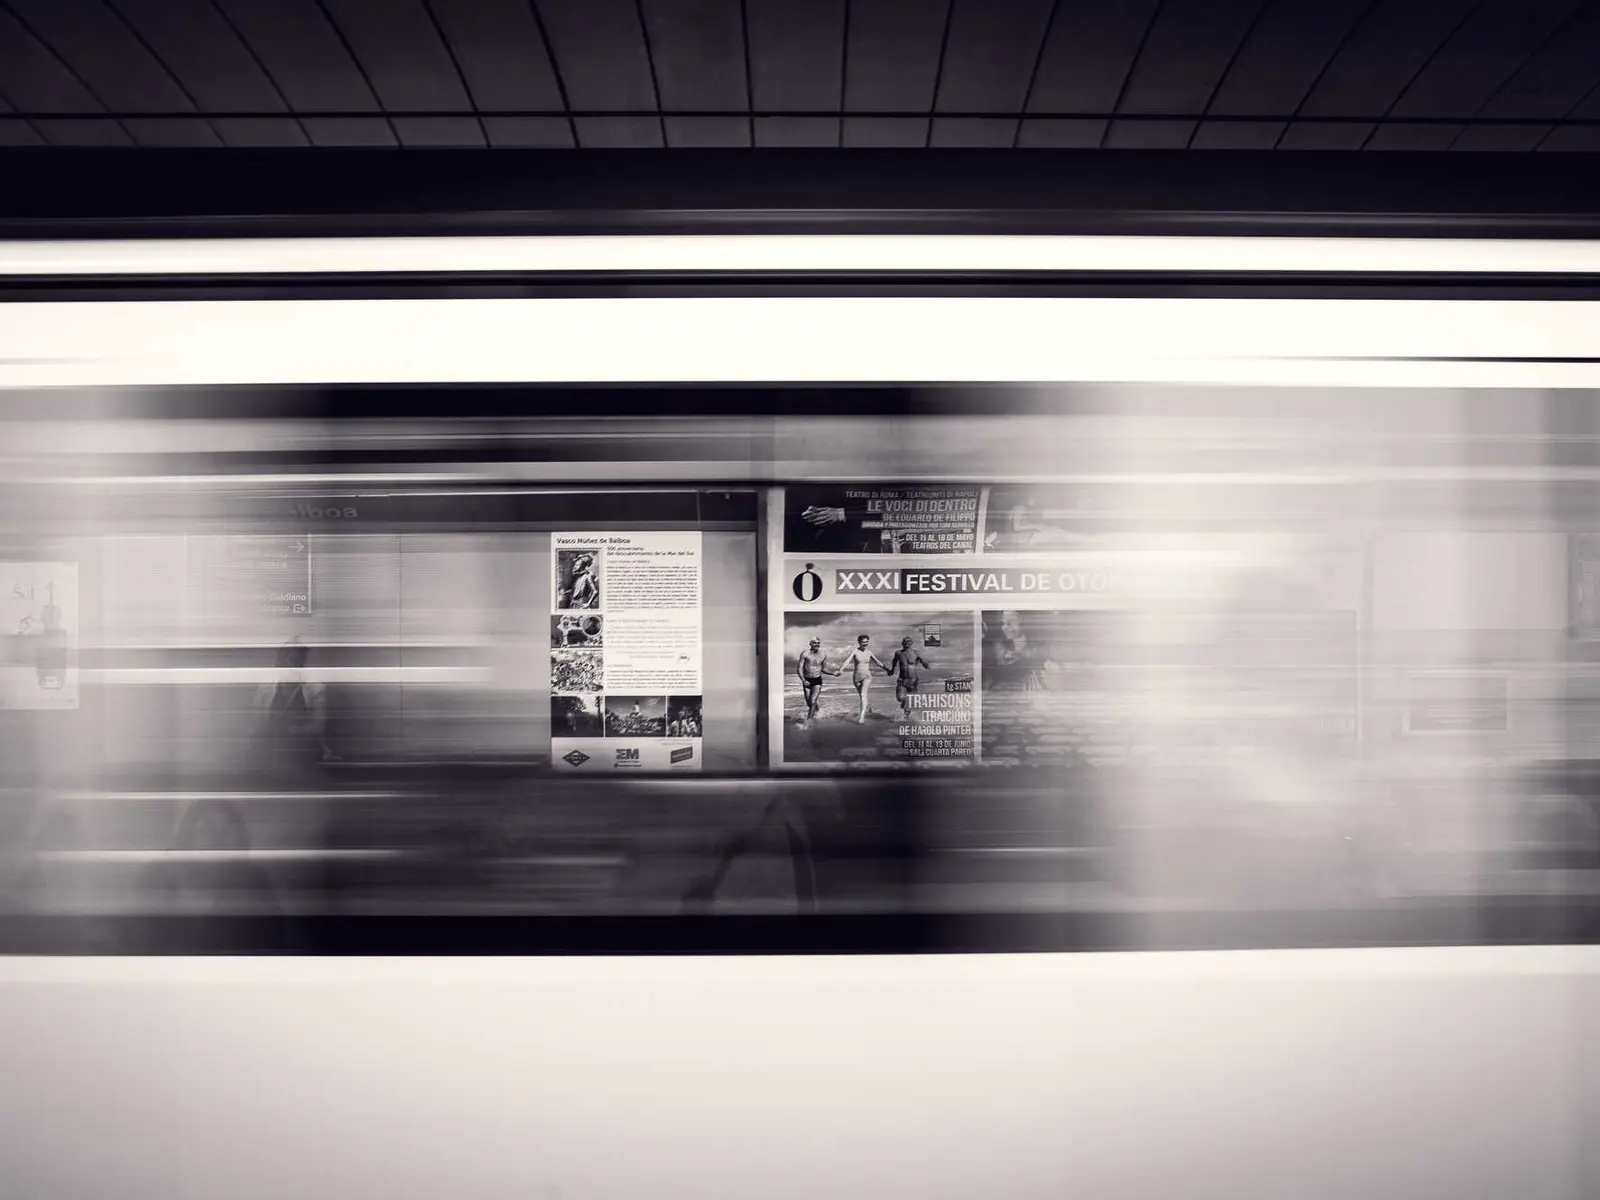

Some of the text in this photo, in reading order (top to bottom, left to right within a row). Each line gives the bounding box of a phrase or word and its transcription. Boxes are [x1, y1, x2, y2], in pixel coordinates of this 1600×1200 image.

[867, 499, 977, 512] LE VOCI DI DENTRO
[883, 513, 893, 521] DE
[934, 513, 943, 521] DE
[945, 512, 976, 521] FILIPPO
[905, 533, 918, 541] DEL
[928, 533, 937, 541] AL
[946, 533, 955, 541] DE
[956, 533, 974, 541] MAYO
[912, 541, 973, 549] TEATROS DEL CANAL
[838, 572, 1113, 591] XXXI FESTIVAL DE OTO
[907, 693, 971, 708] TRAHISONS
[899, 725, 971, 736] DE HAROLD PINTER
[904, 740, 916, 748] DEL
[950, 748, 971, 756] PARED
